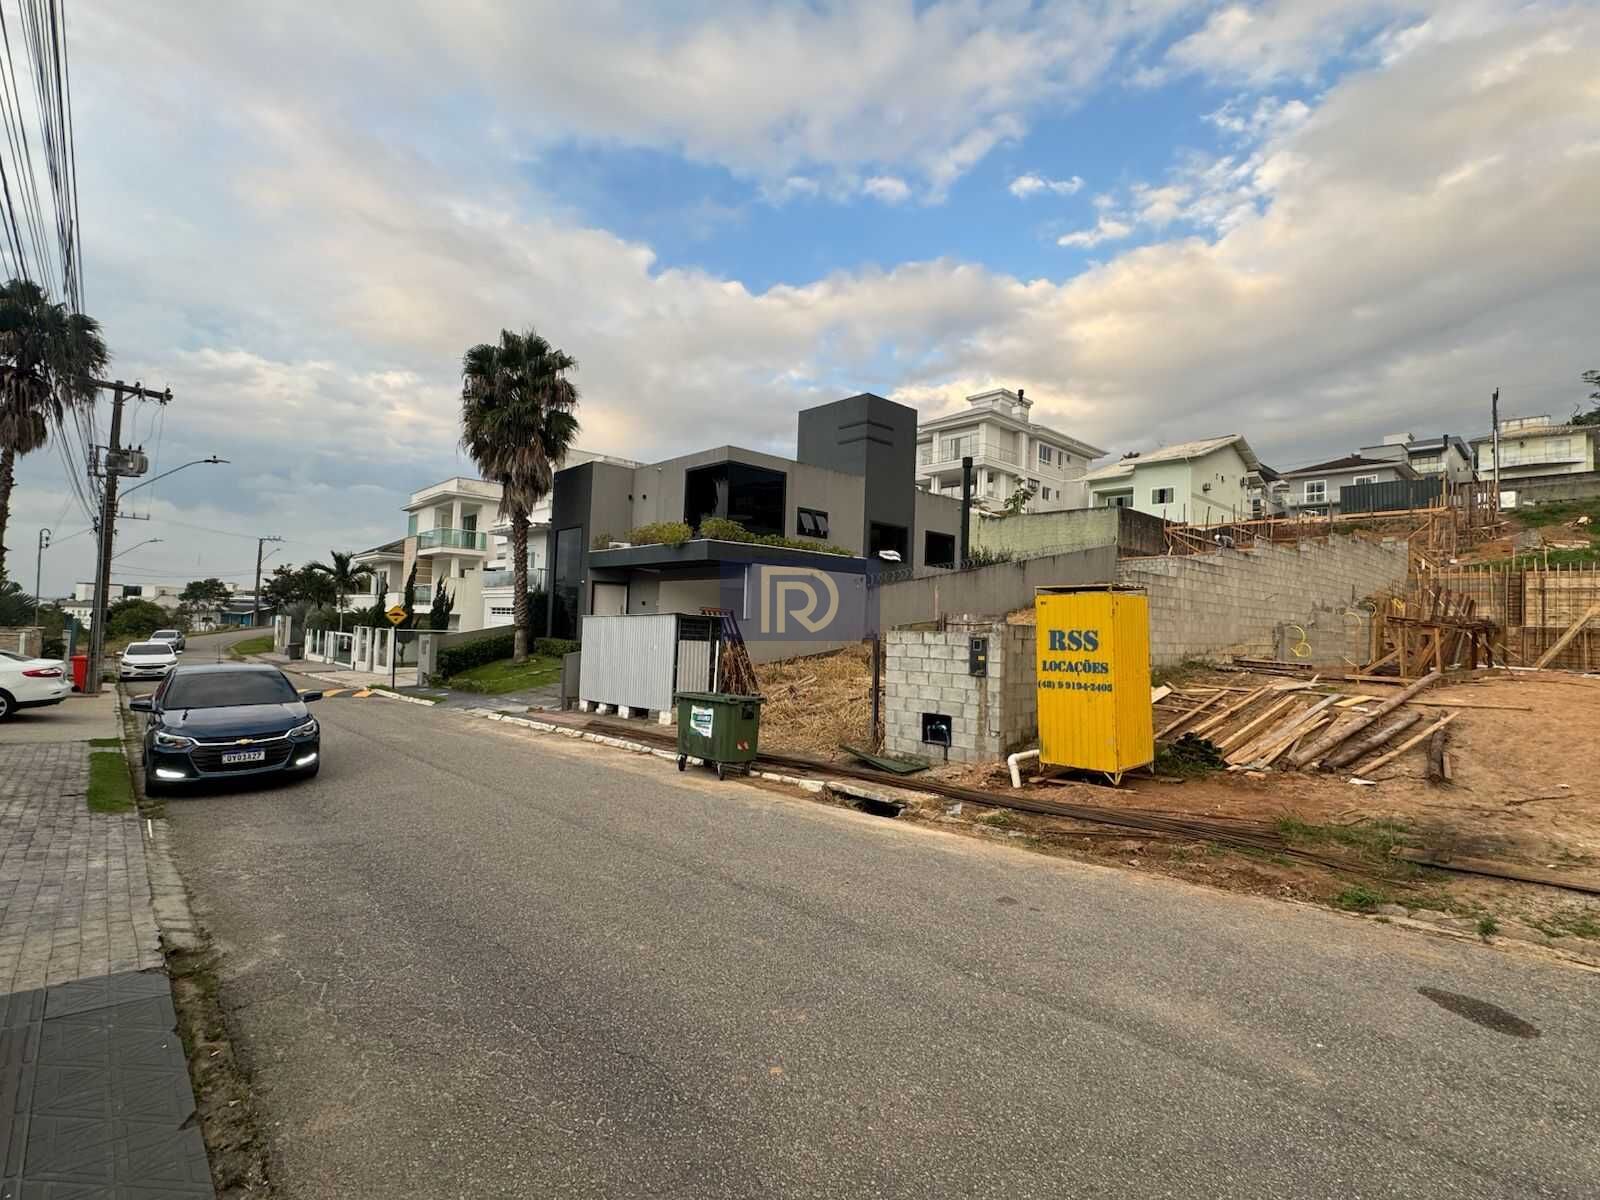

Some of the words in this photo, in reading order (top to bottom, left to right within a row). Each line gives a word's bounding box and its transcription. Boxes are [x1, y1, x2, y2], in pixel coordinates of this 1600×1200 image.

[1048, 630, 1099, 651] RSS
[1042, 660, 1109, 676] LOCAÇÕES
[1038, 680, 1056, 690] (48)
